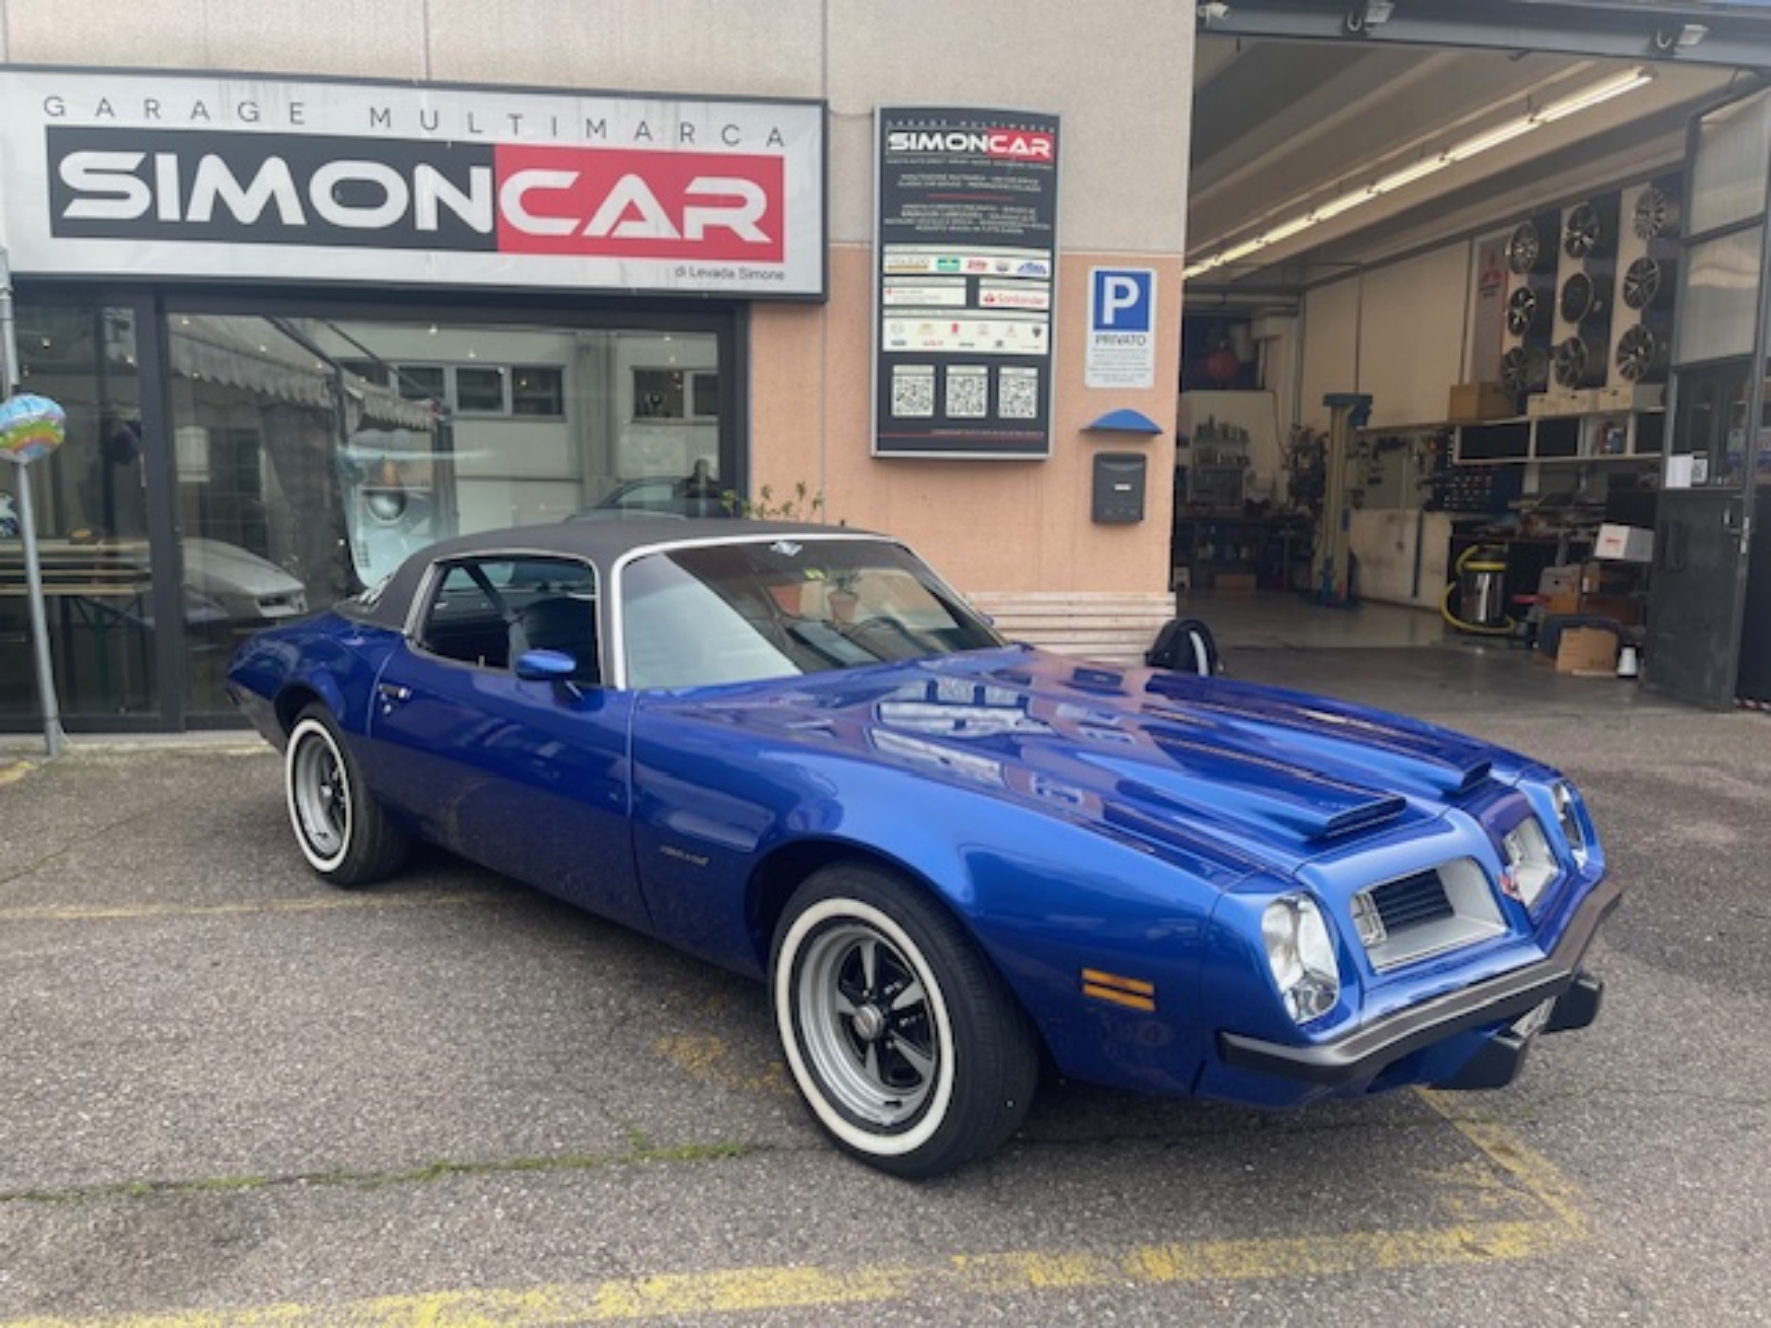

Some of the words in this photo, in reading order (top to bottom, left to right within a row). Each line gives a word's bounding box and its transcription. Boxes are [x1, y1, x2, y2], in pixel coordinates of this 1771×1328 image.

[43, 96, 306, 125] GARAGE
[369, 106, 785, 148] MULTIMARCA
[888, 132, 1050, 158] SIMONCAR
[58, 150, 773, 244] SIMONCAR
[738, 267, 785, 281] Simone
[1103, 276, 1140, 325] P
[1095, 334, 1147, 346] PRIVATO
